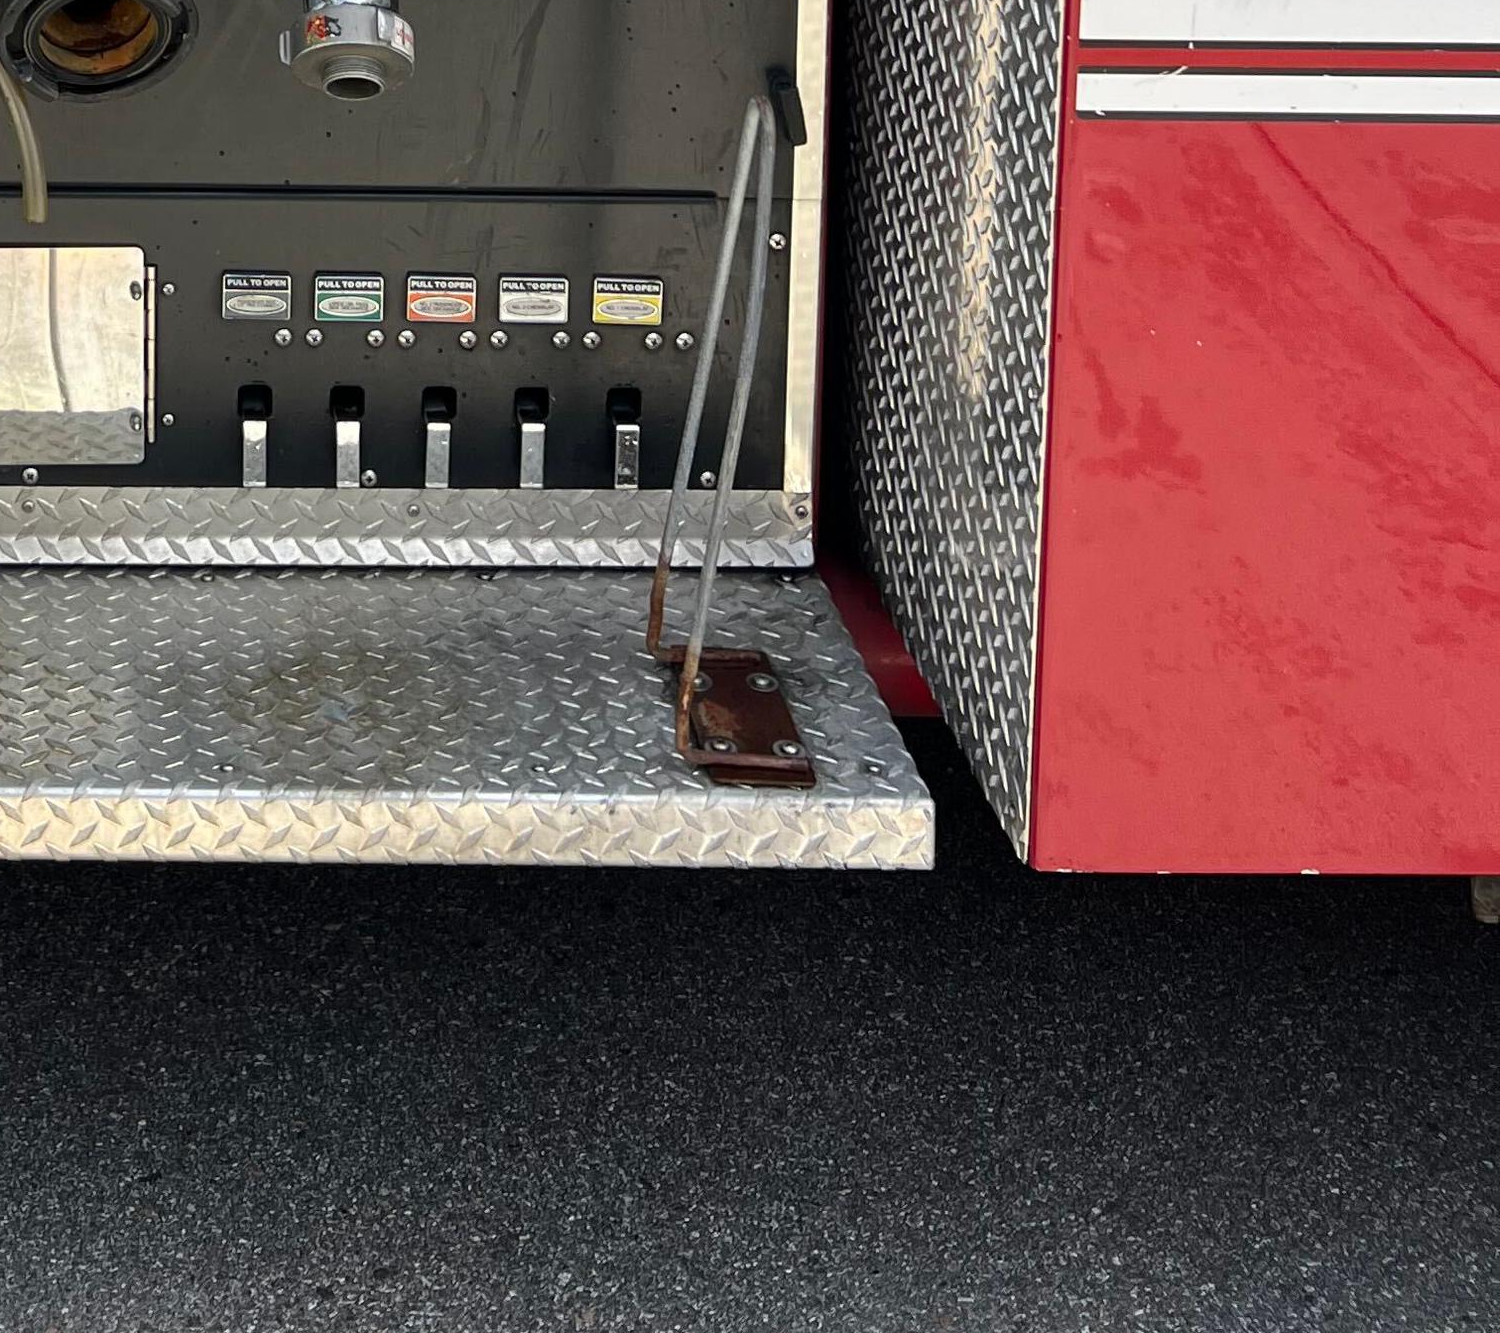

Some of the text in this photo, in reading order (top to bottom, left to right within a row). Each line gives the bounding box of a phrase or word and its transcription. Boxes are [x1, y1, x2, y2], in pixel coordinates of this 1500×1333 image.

[263, 279, 287, 287] OPEN
[318, 280, 341, 288] PULL
[342, 280, 354, 288] TO
[411, 280, 433, 288] PULL
[448, 281, 472, 289] OPEN
[502, 282, 526, 290] PULL
[540, 282, 565, 290] OPEN
[597, 283, 660, 292] PULL TO OPEN
